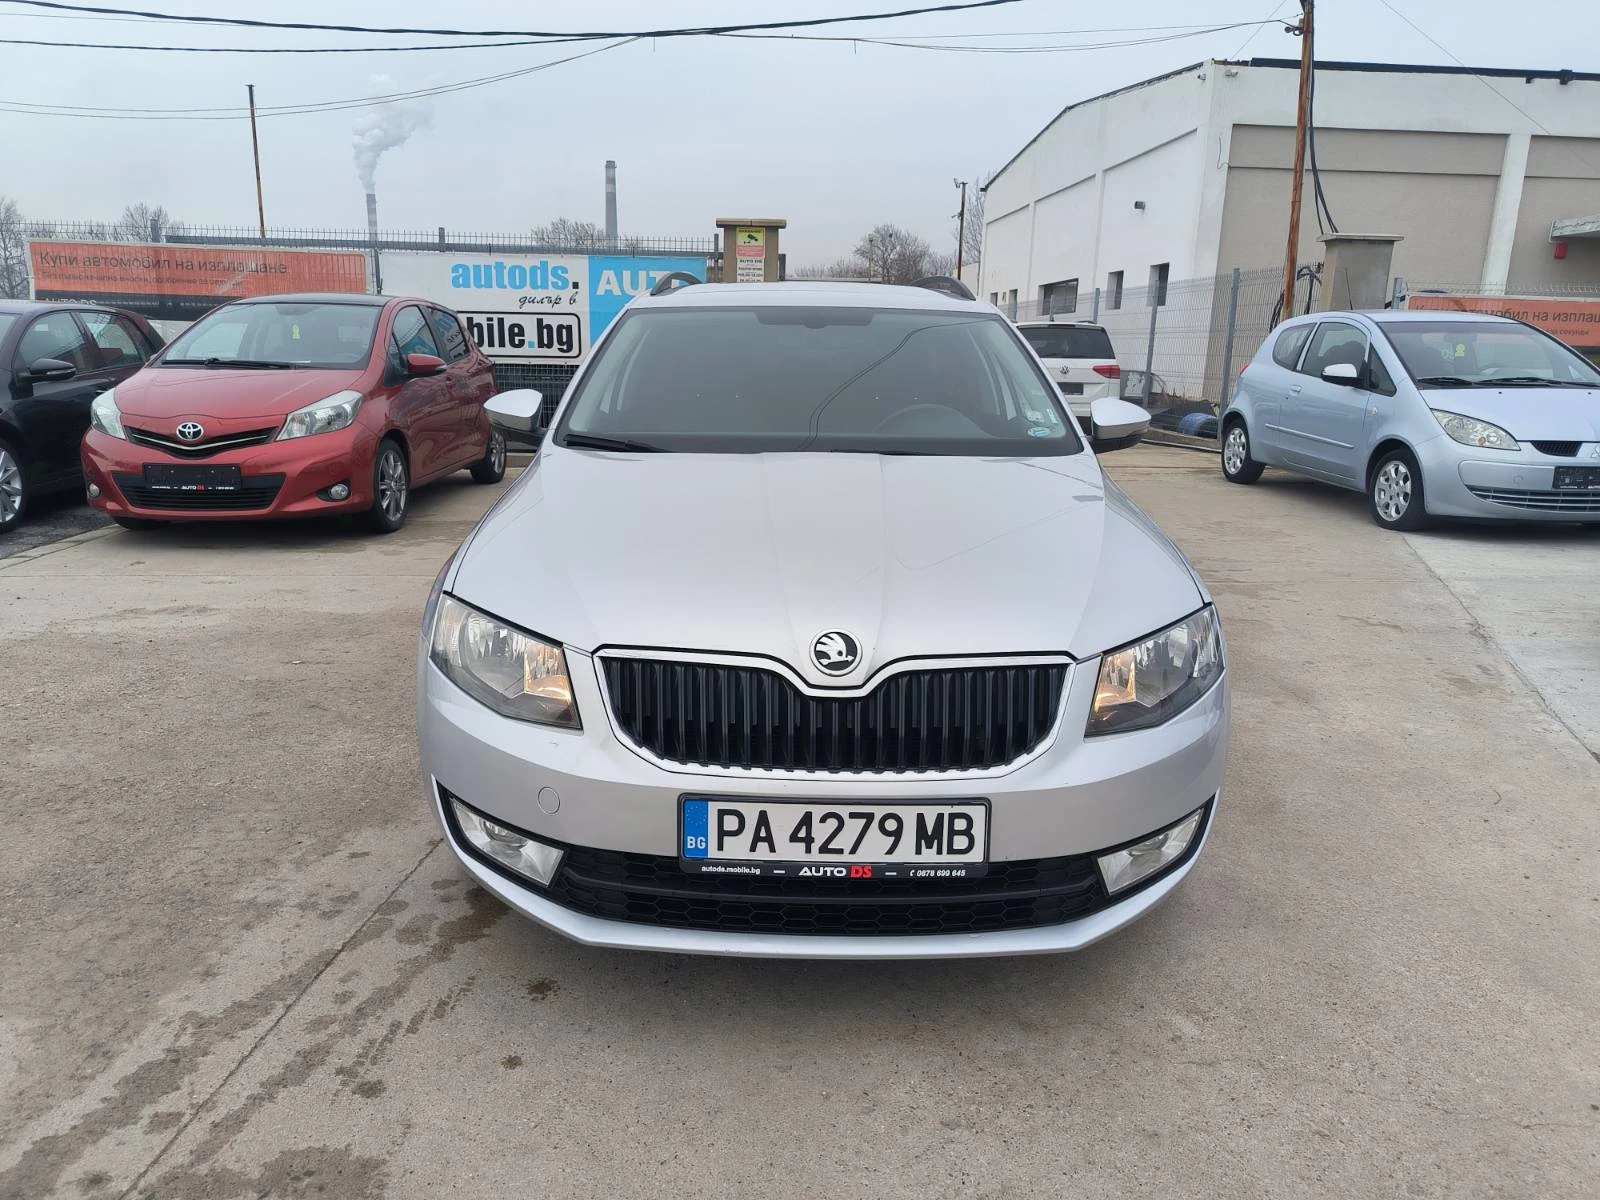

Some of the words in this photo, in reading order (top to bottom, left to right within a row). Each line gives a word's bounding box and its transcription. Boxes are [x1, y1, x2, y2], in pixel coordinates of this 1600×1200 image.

[40, 252, 78, 268] Купи
[83, 255, 170, 269] автомобил
[175, 259, 194, 271] на
[198, 260, 288, 274] изплащане
[451, 260, 579, 290] autods.
[1532, 311, 1549, 321] на
[467, 316, 574, 353] bile.bg
[686, 836, 706, 849] BG
[716, 808, 777, 853] PA
[788, 810, 904, 855] 4279
[914, 812, 976, 856] MB
[701, 865, 761, 875] autods.mobile.bg
[798, 866, 847, 877] AUTO
[850, 865, 872, 878] DS
[916, 869, 935, 877] 0878
[936, 869, 950, 877] 699
[951, 869, 966, 877] 645
